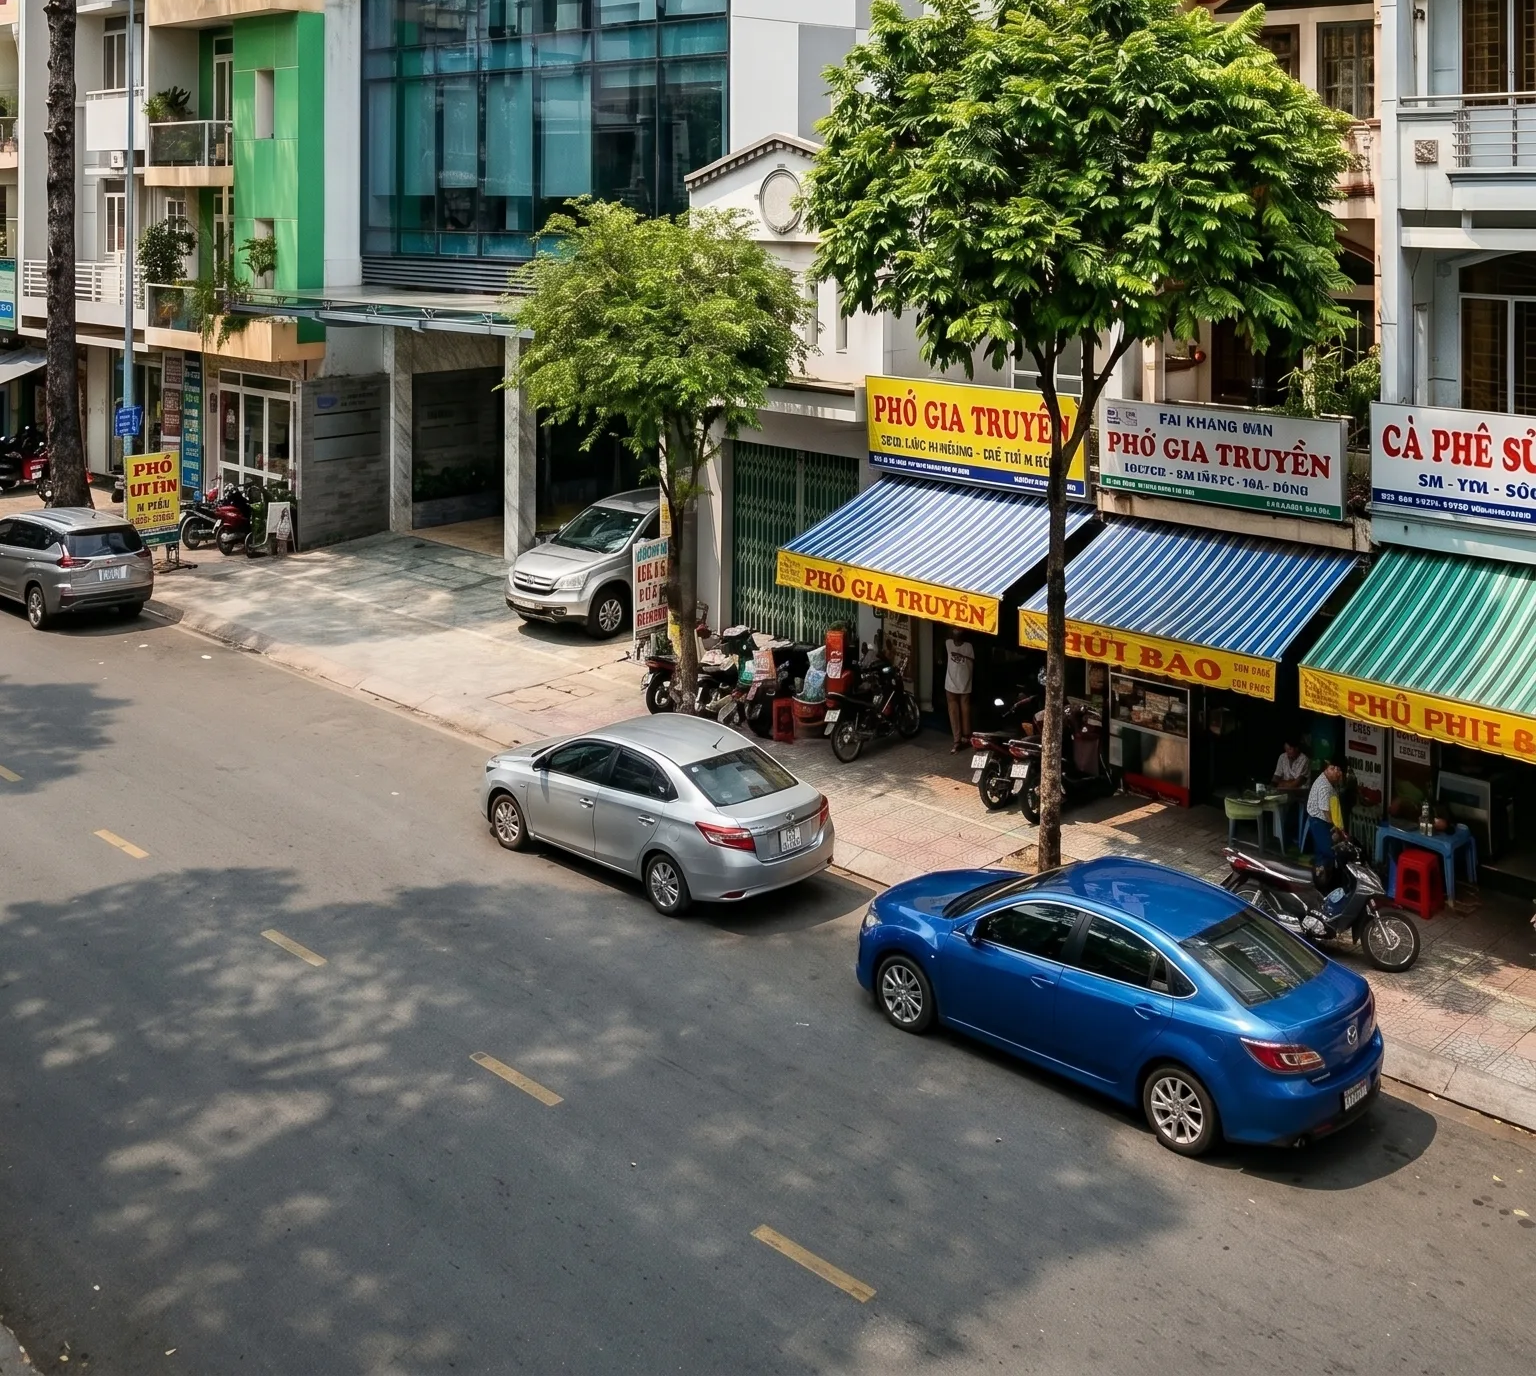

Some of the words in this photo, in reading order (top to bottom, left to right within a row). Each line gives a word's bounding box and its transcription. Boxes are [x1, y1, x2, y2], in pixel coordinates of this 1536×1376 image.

[924, 400, 966, 433] GIA
[1159, 412, 1181, 427] FAI
[1382, 415, 1424, 461] CÀ
[1431, 421, 1494, 469] PHÊ
[1163, 437, 1210, 464] GIA
[1215, 438, 1332, 480] TRUYỀN
[1418, 473, 1444, 489] SM
[851, 578, 889, 605] GIA
